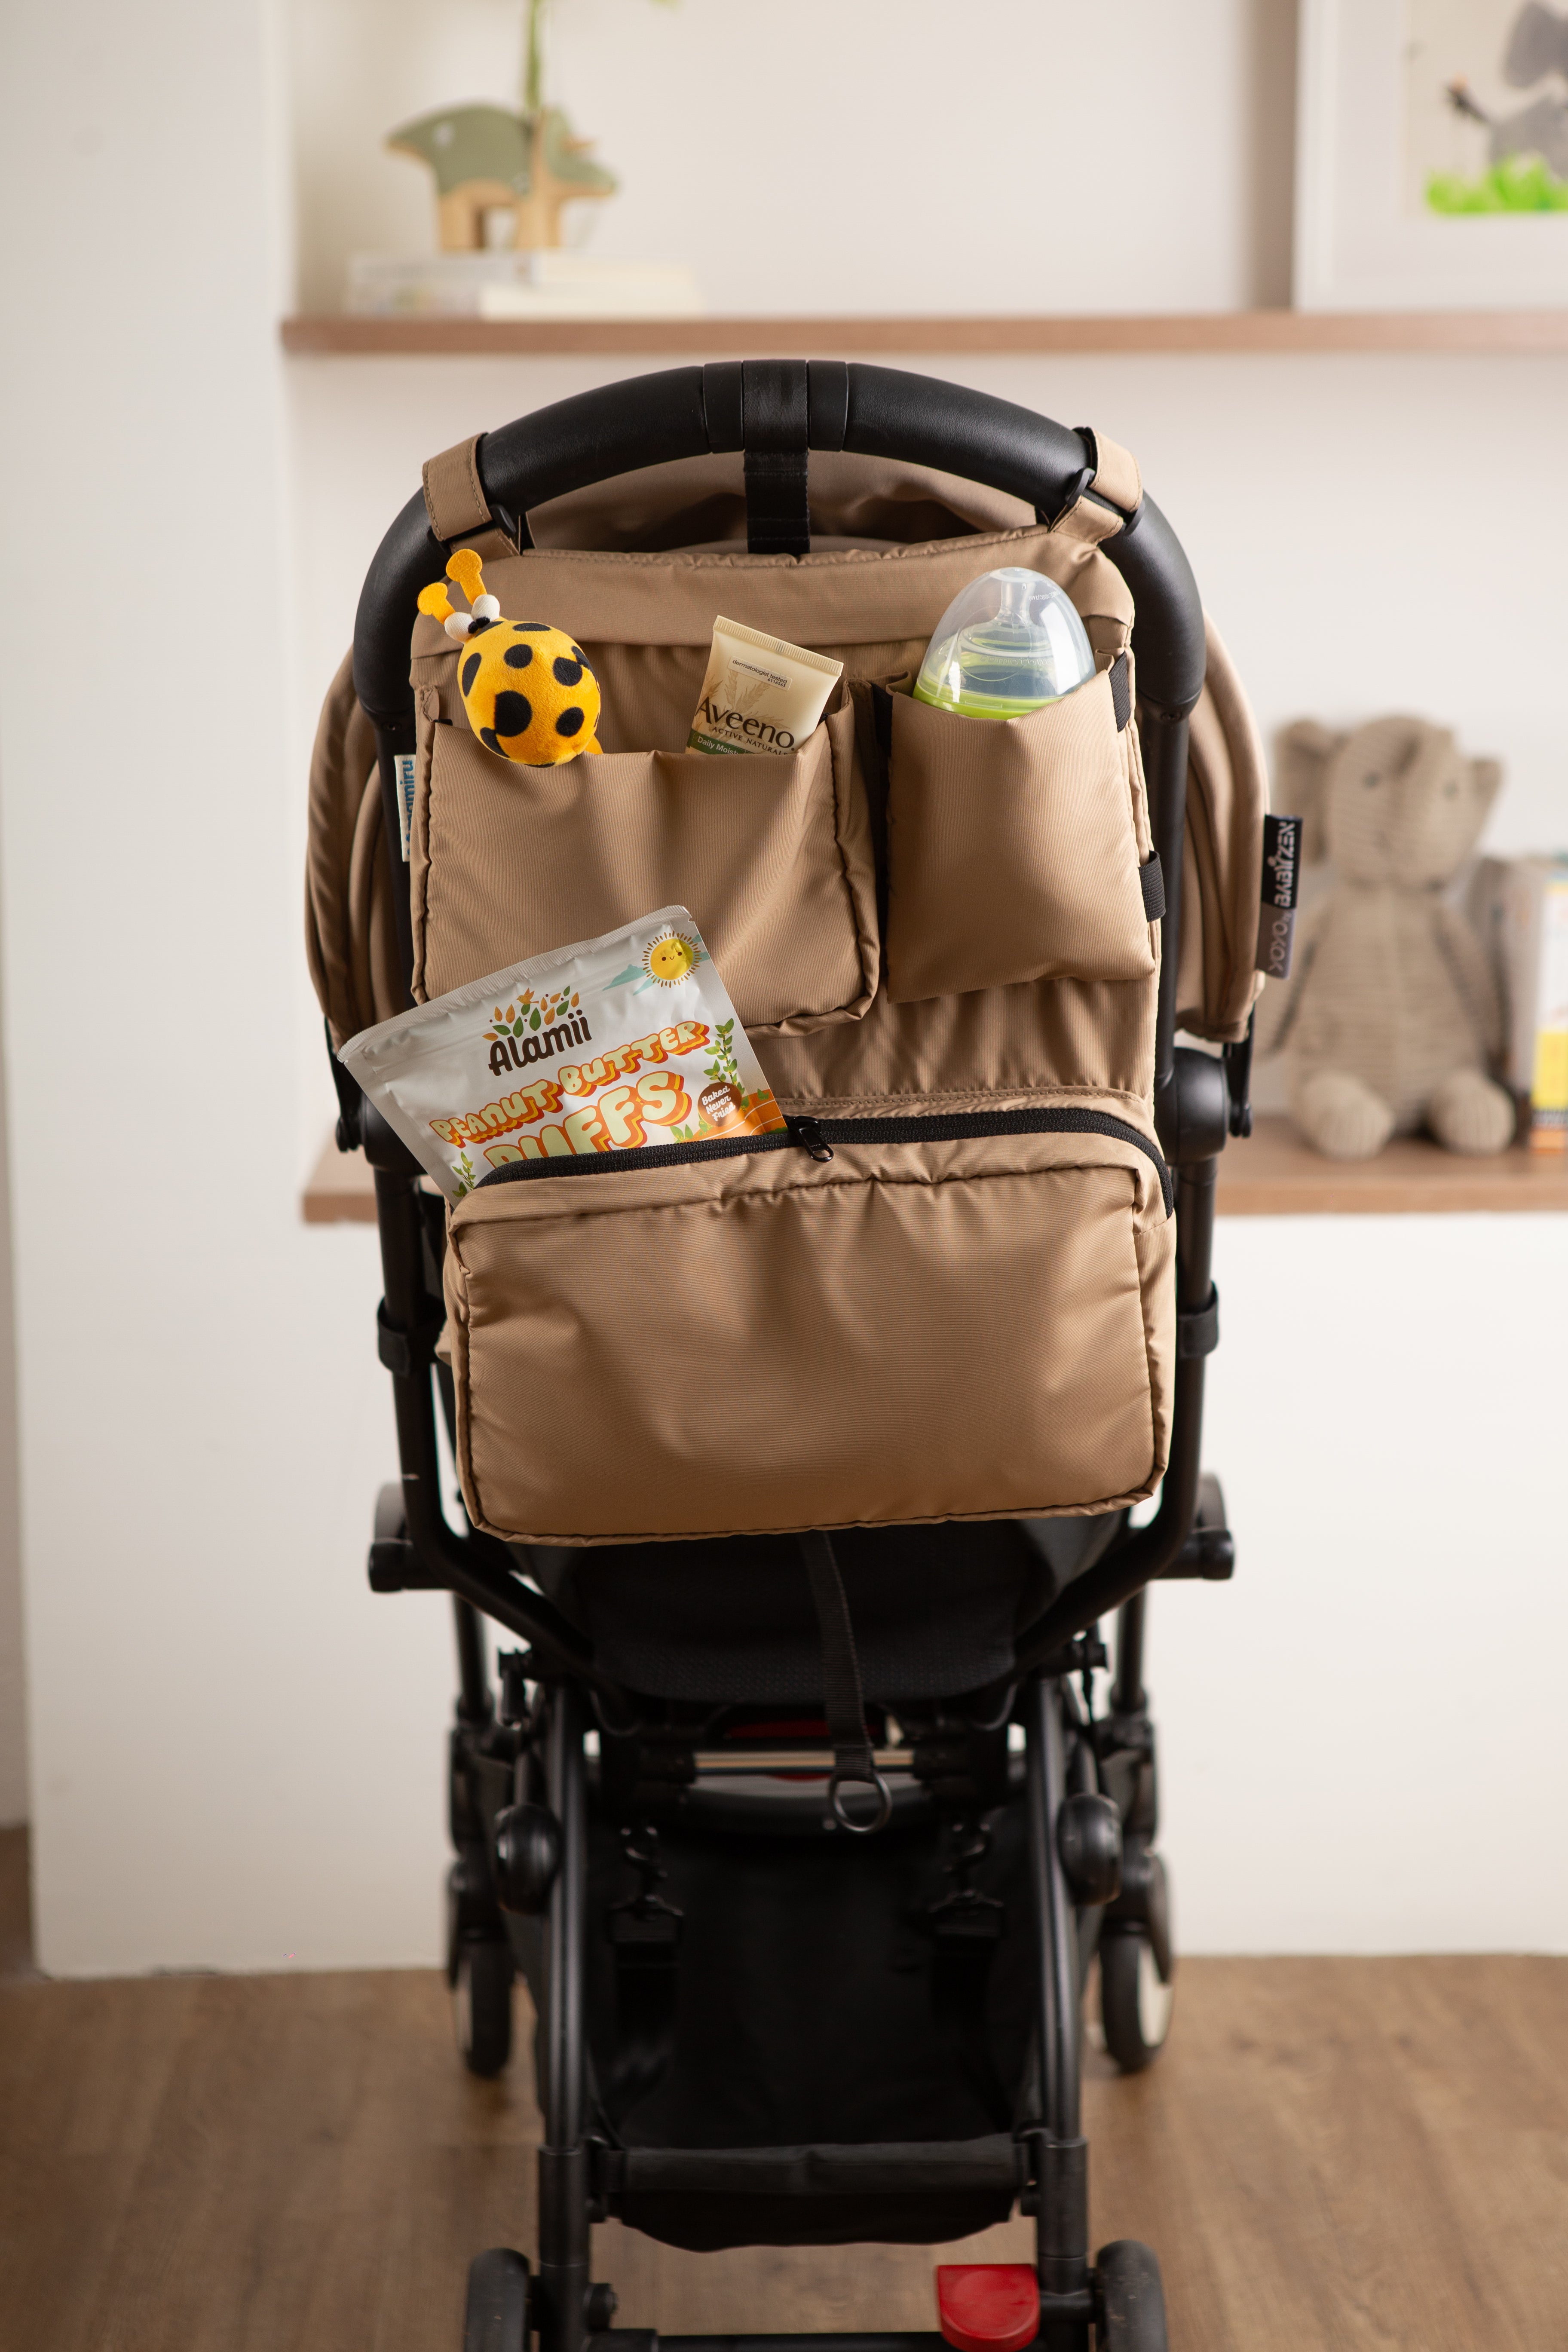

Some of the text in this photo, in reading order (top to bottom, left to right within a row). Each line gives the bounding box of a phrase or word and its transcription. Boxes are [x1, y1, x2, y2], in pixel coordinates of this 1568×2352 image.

[980, 655, 1054, 666] comotom
[732, 660, 787, 684] dermatologist tested
[767, 678, 786, 688] 6116563
[697, 736, 715, 749] Daily
[712, 726, 743, 741] ACTIVE
[1268, 821, 1295, 908] BABYZEN
[488, 1009, 592, 1076] Alamii
[429, 1020, 710, 1148] PEANUT BUTTER
[701, 1085, 730, 1106] Baked
[705, 1095, 731, 1115] Never
[711, 1101, 735, 1121] Fried
